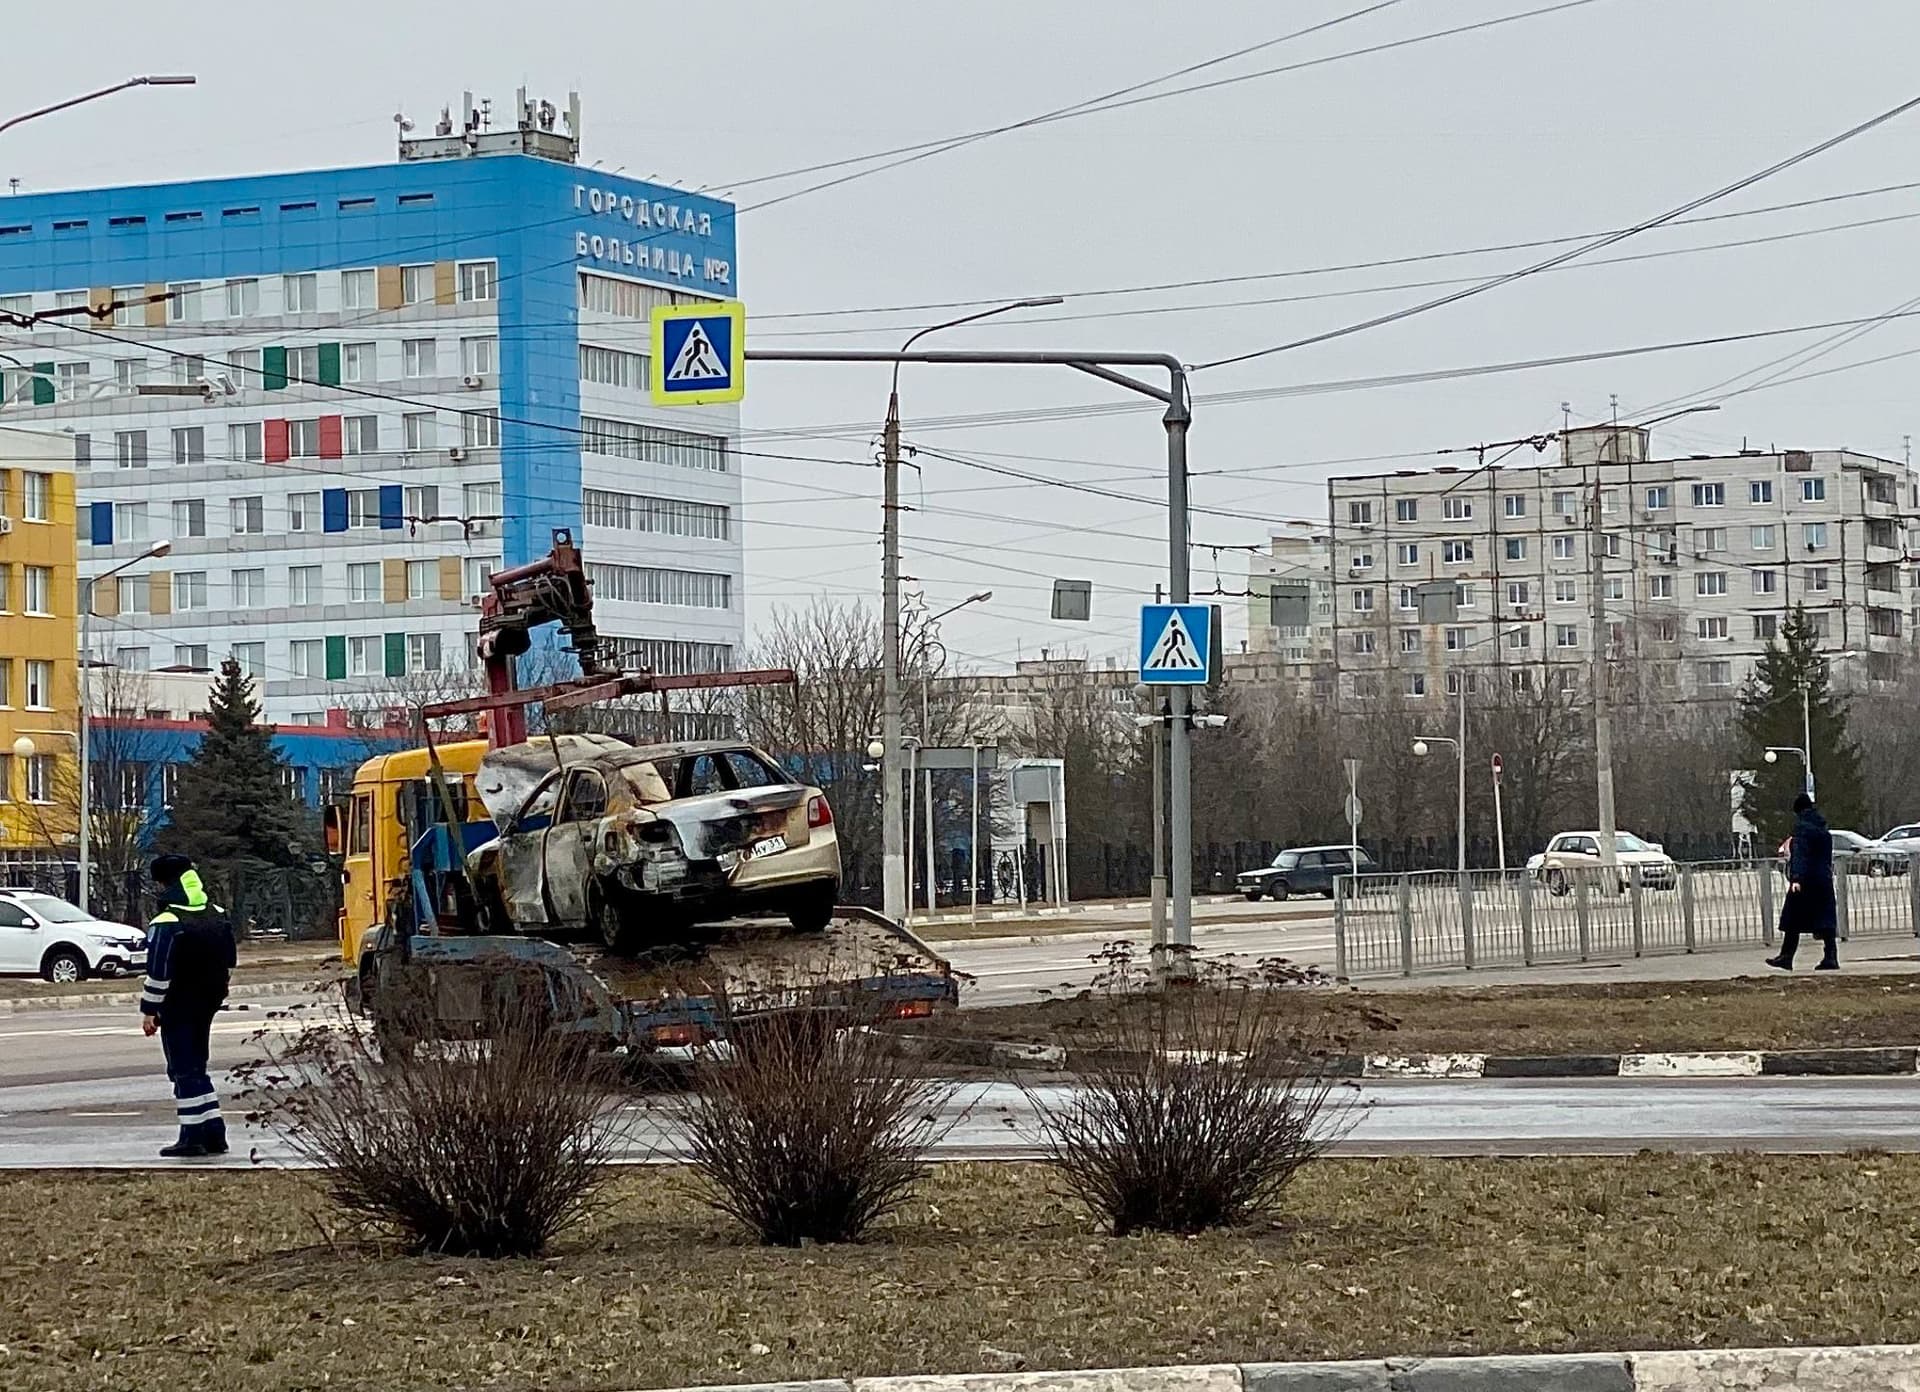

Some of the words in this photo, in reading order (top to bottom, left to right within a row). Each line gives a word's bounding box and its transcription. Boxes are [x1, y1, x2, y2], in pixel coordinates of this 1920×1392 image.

[573, 184, 711, 236] ГОРОДСКАЯ
[575, 231, 695, 280] БОЛЬНИЦА
[704, 257, 730, 284] №2
